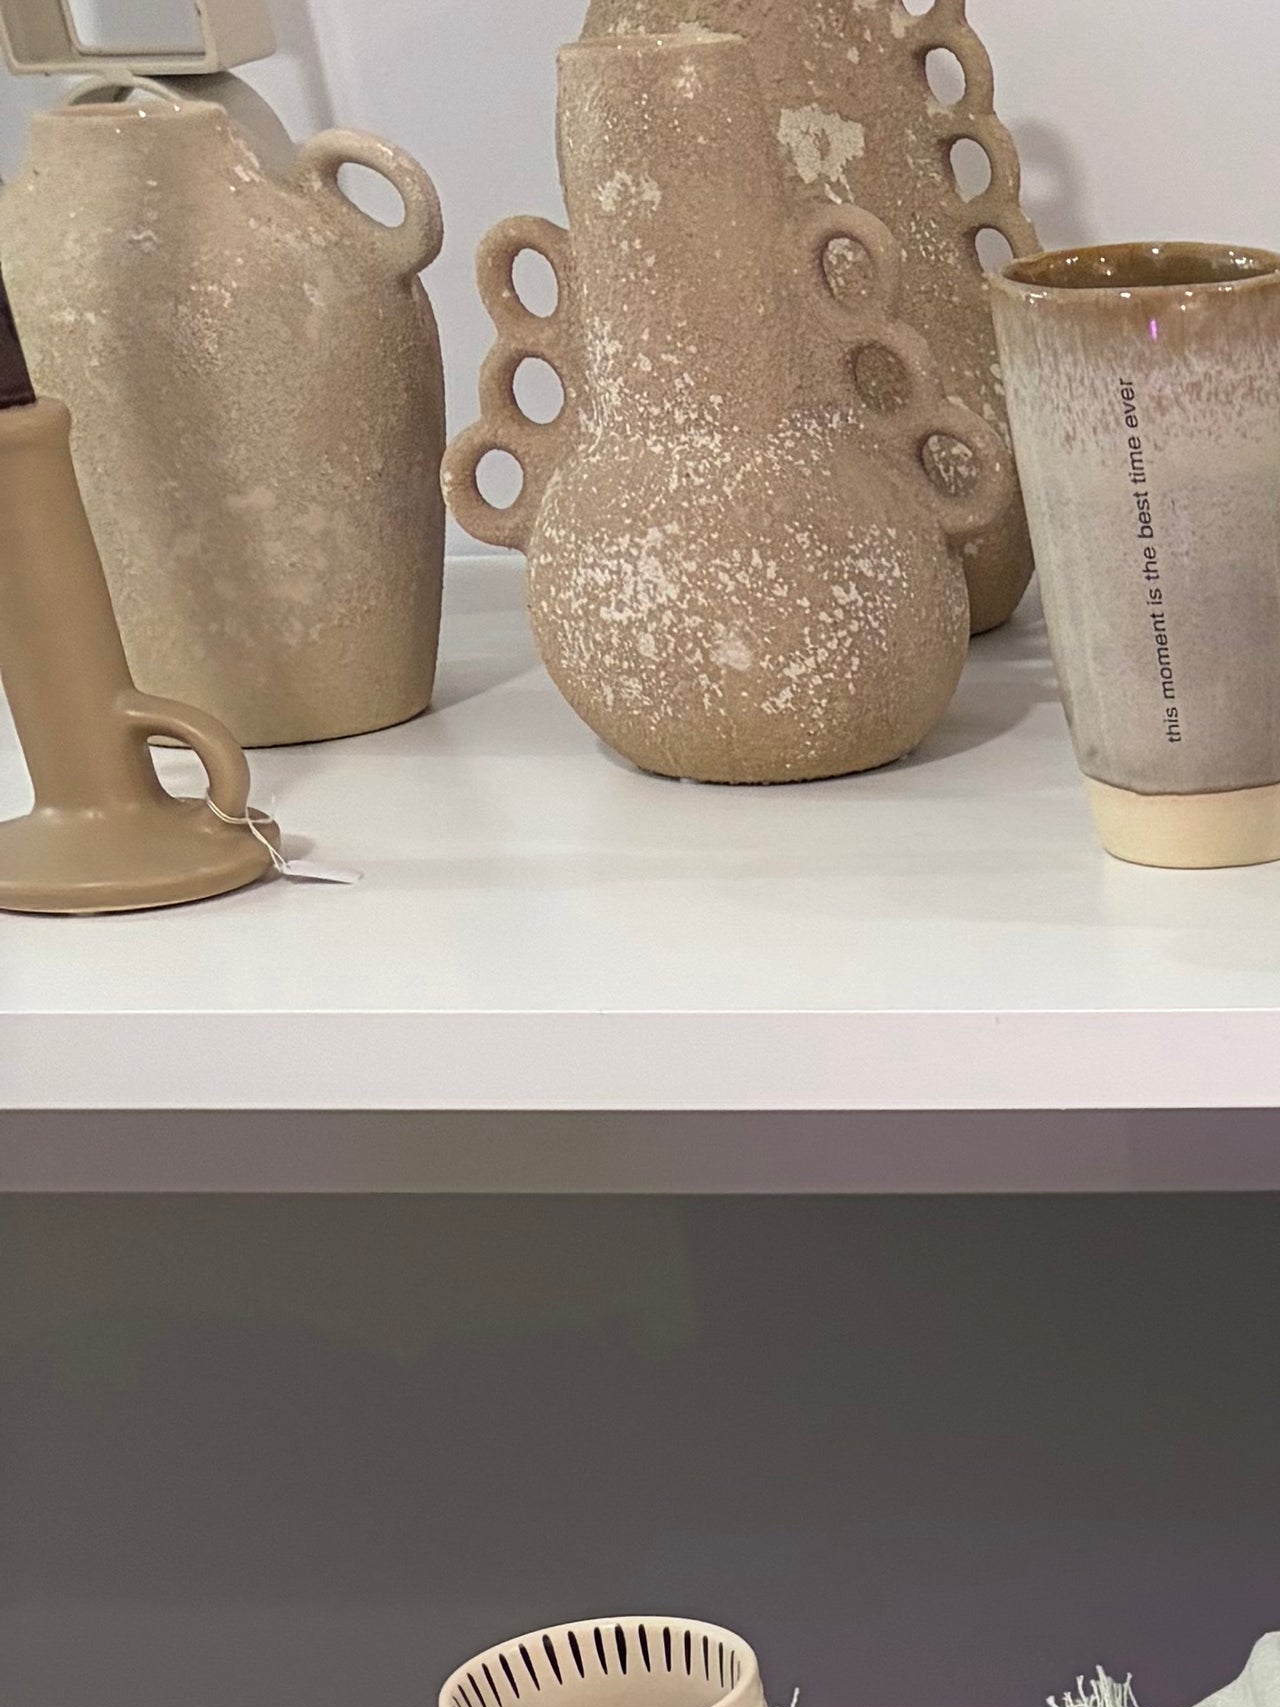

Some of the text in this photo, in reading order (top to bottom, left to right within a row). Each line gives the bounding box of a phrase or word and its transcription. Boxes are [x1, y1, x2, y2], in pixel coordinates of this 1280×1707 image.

[1119, 378, 1182, 743] this moment is the best time ever
